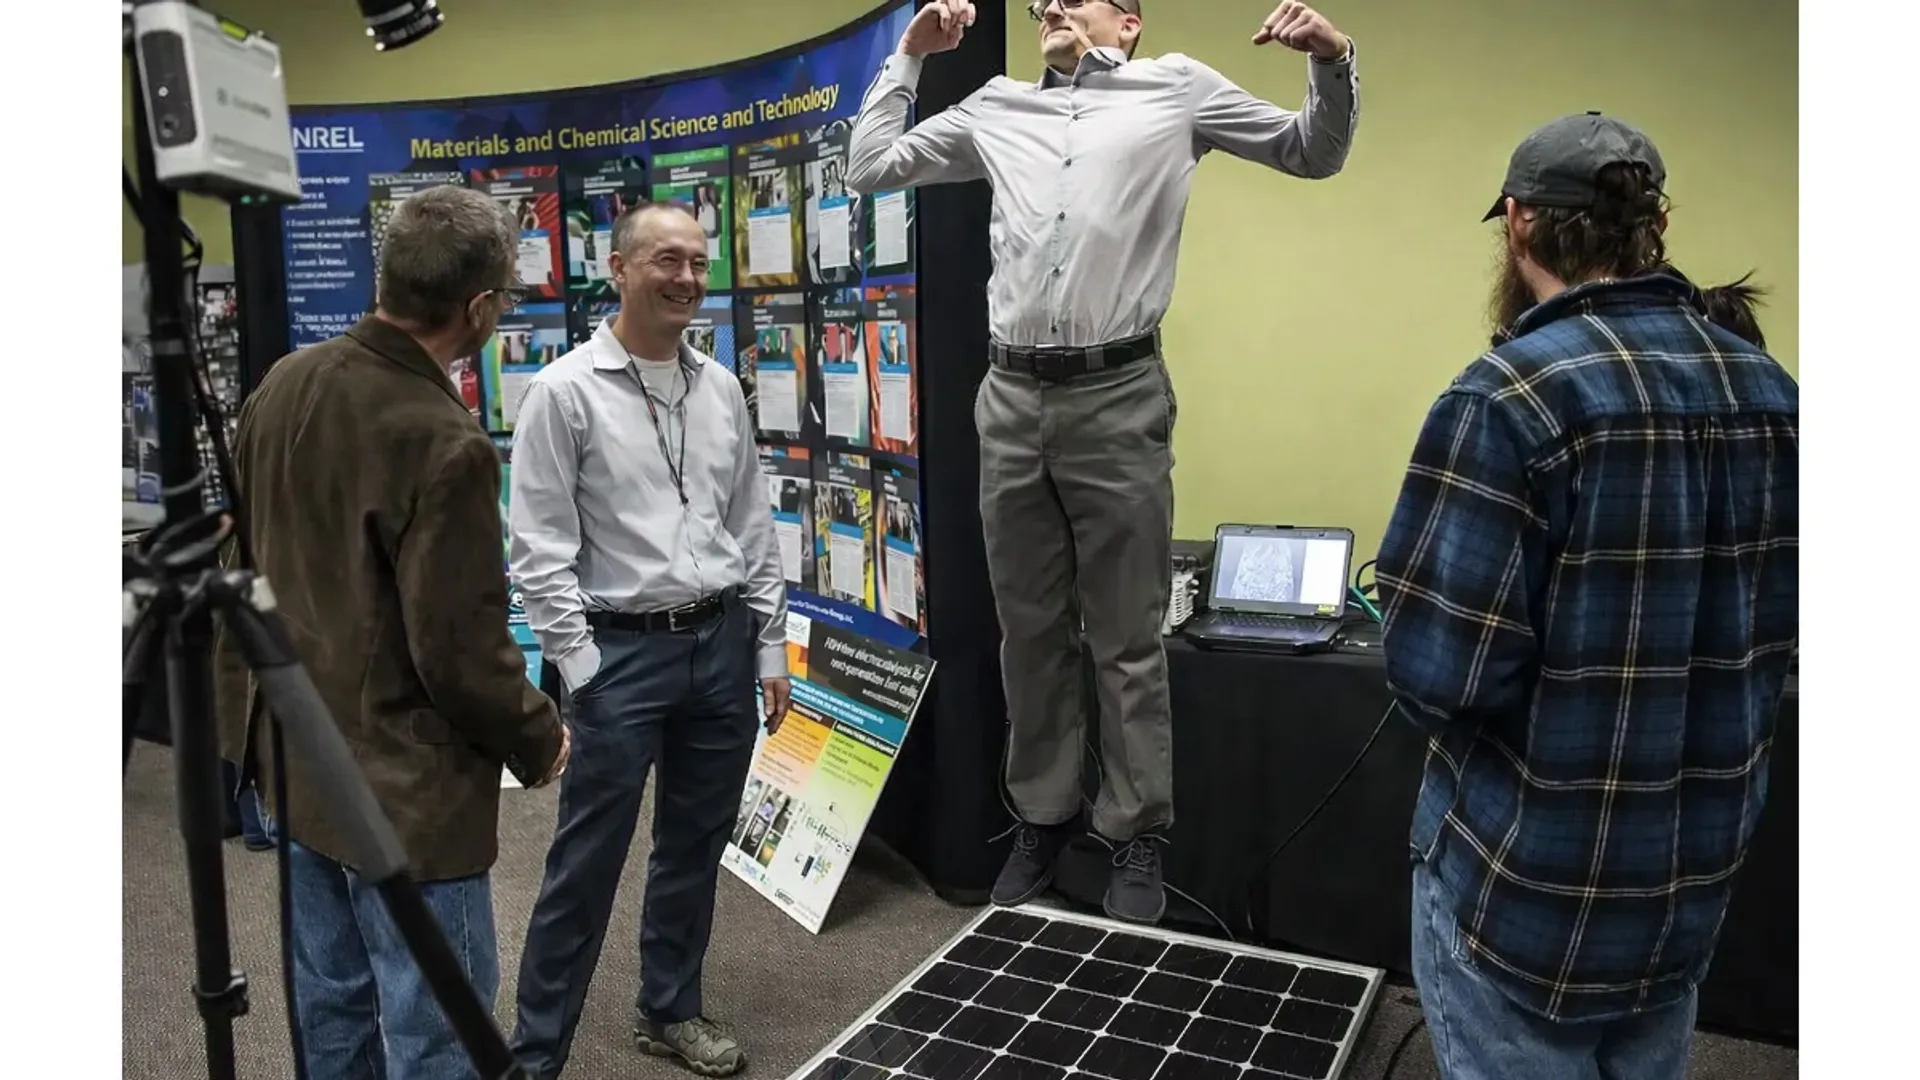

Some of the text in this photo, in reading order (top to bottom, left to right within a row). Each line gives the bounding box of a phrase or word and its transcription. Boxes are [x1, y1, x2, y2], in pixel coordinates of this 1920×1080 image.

[291, 126, 364, 149] NREL
[410, 83, 840, 159] Materials and Chemical Science and Technology
